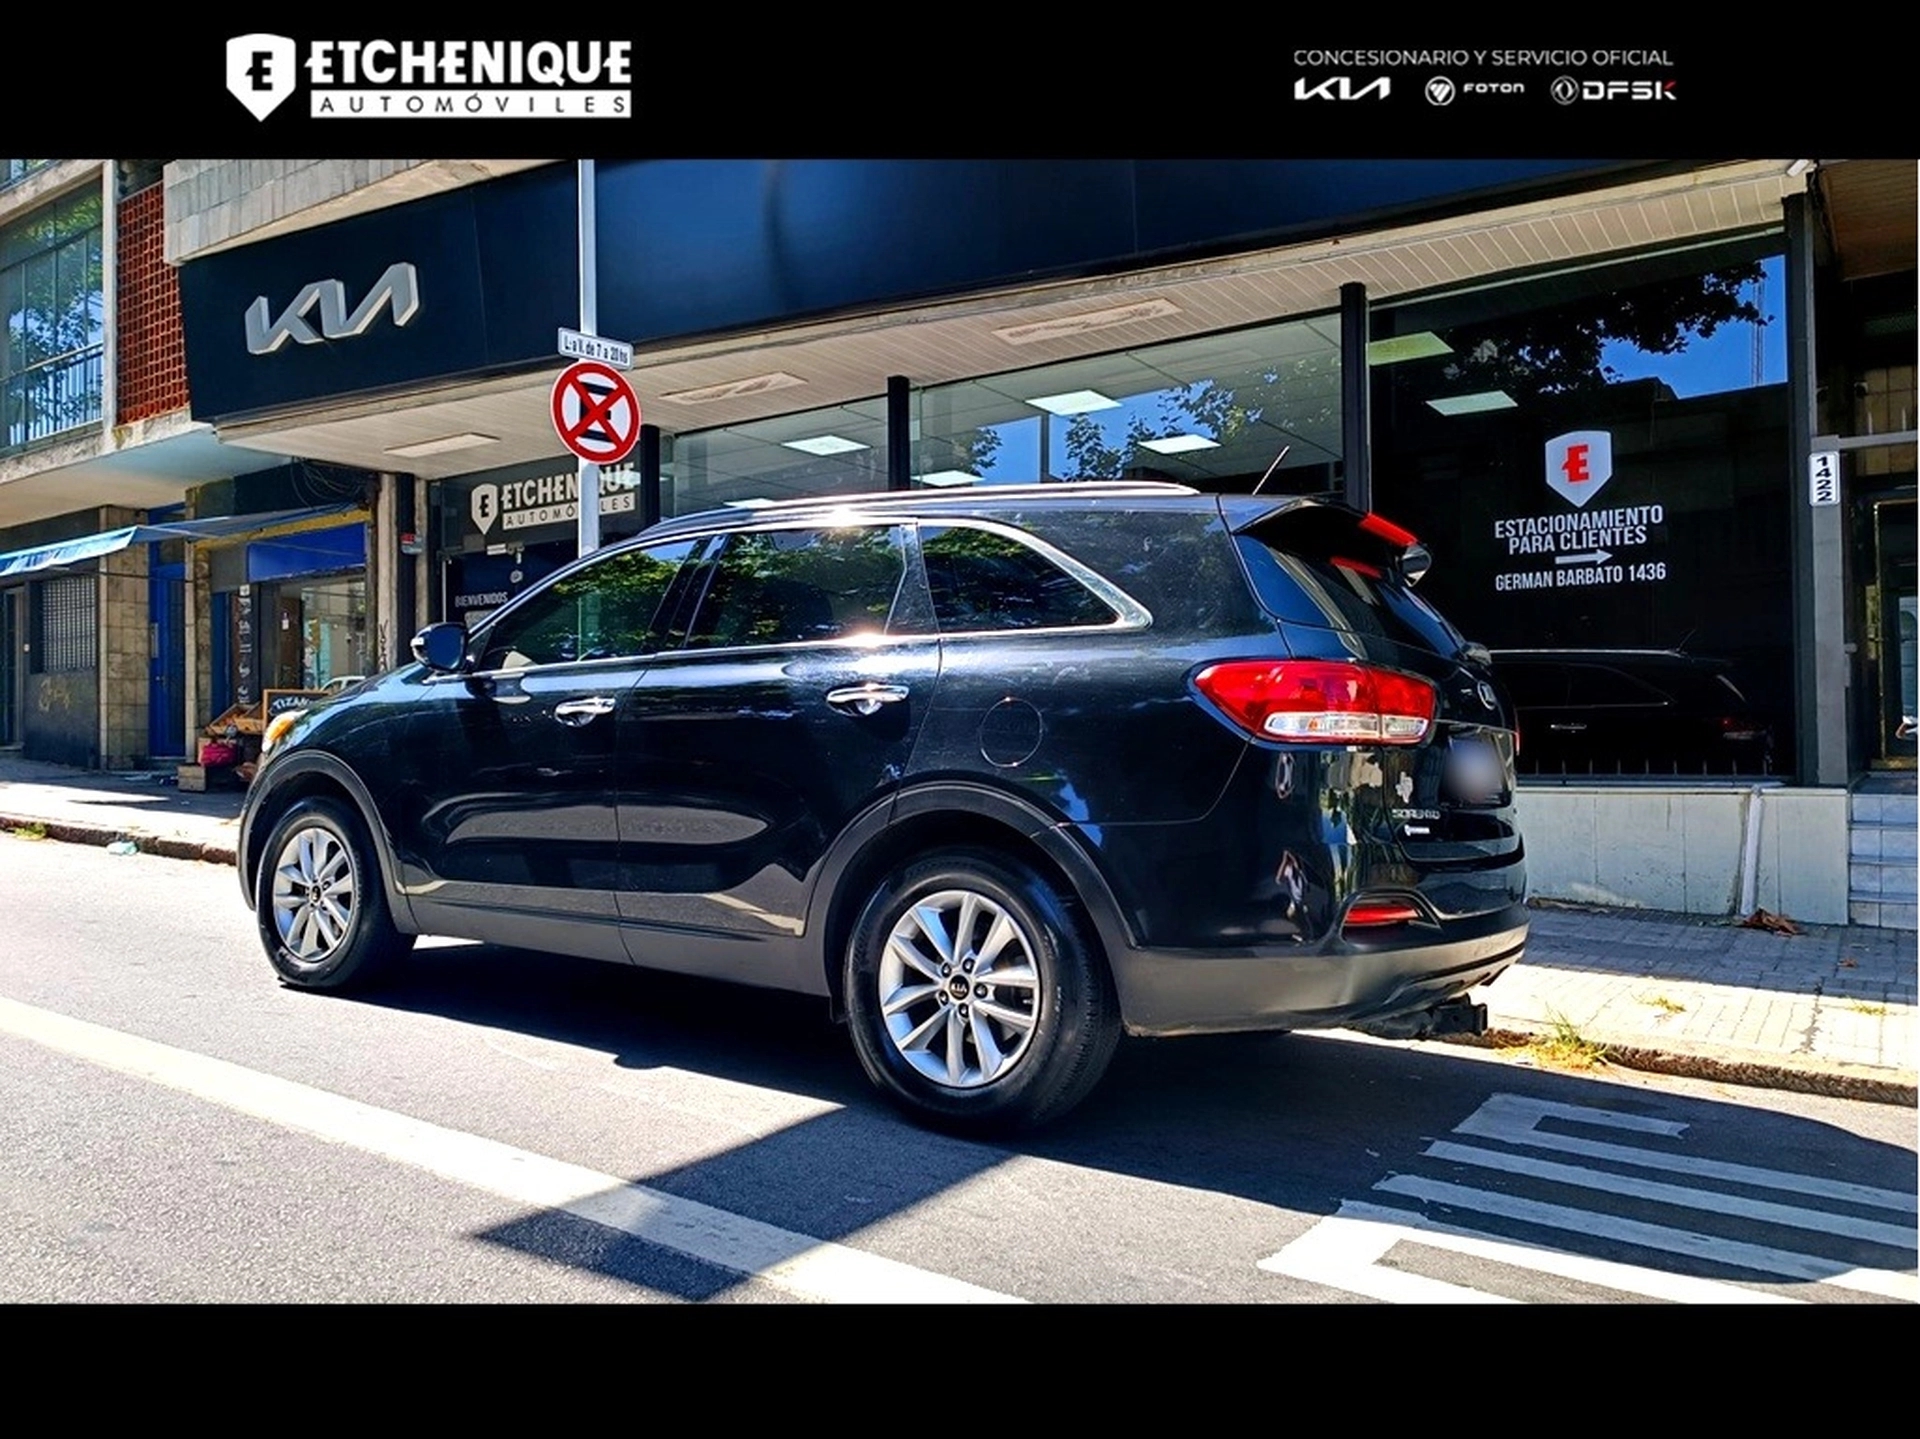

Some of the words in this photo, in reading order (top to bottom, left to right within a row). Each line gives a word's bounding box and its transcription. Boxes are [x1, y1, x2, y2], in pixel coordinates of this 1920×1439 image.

[245, 262, 419, 355] KIA
[501, 462, 635, 510] ETCHENUE
[1815, 456, 1832, 502] 1422
[505, 496, 631, 526] AUTOMÓLES
[1494, 504, 1663, 538] ESTACIONAMIENTO
[1509, 534, 1555, 555] PARA
[1560, 525, 1647, 551] CLIENTES
[1495, 570, 1553, 591] GERMAN
[1556, 565, 1623, 587] BARBATO
[1628, 562, 1667, 582] 1436
